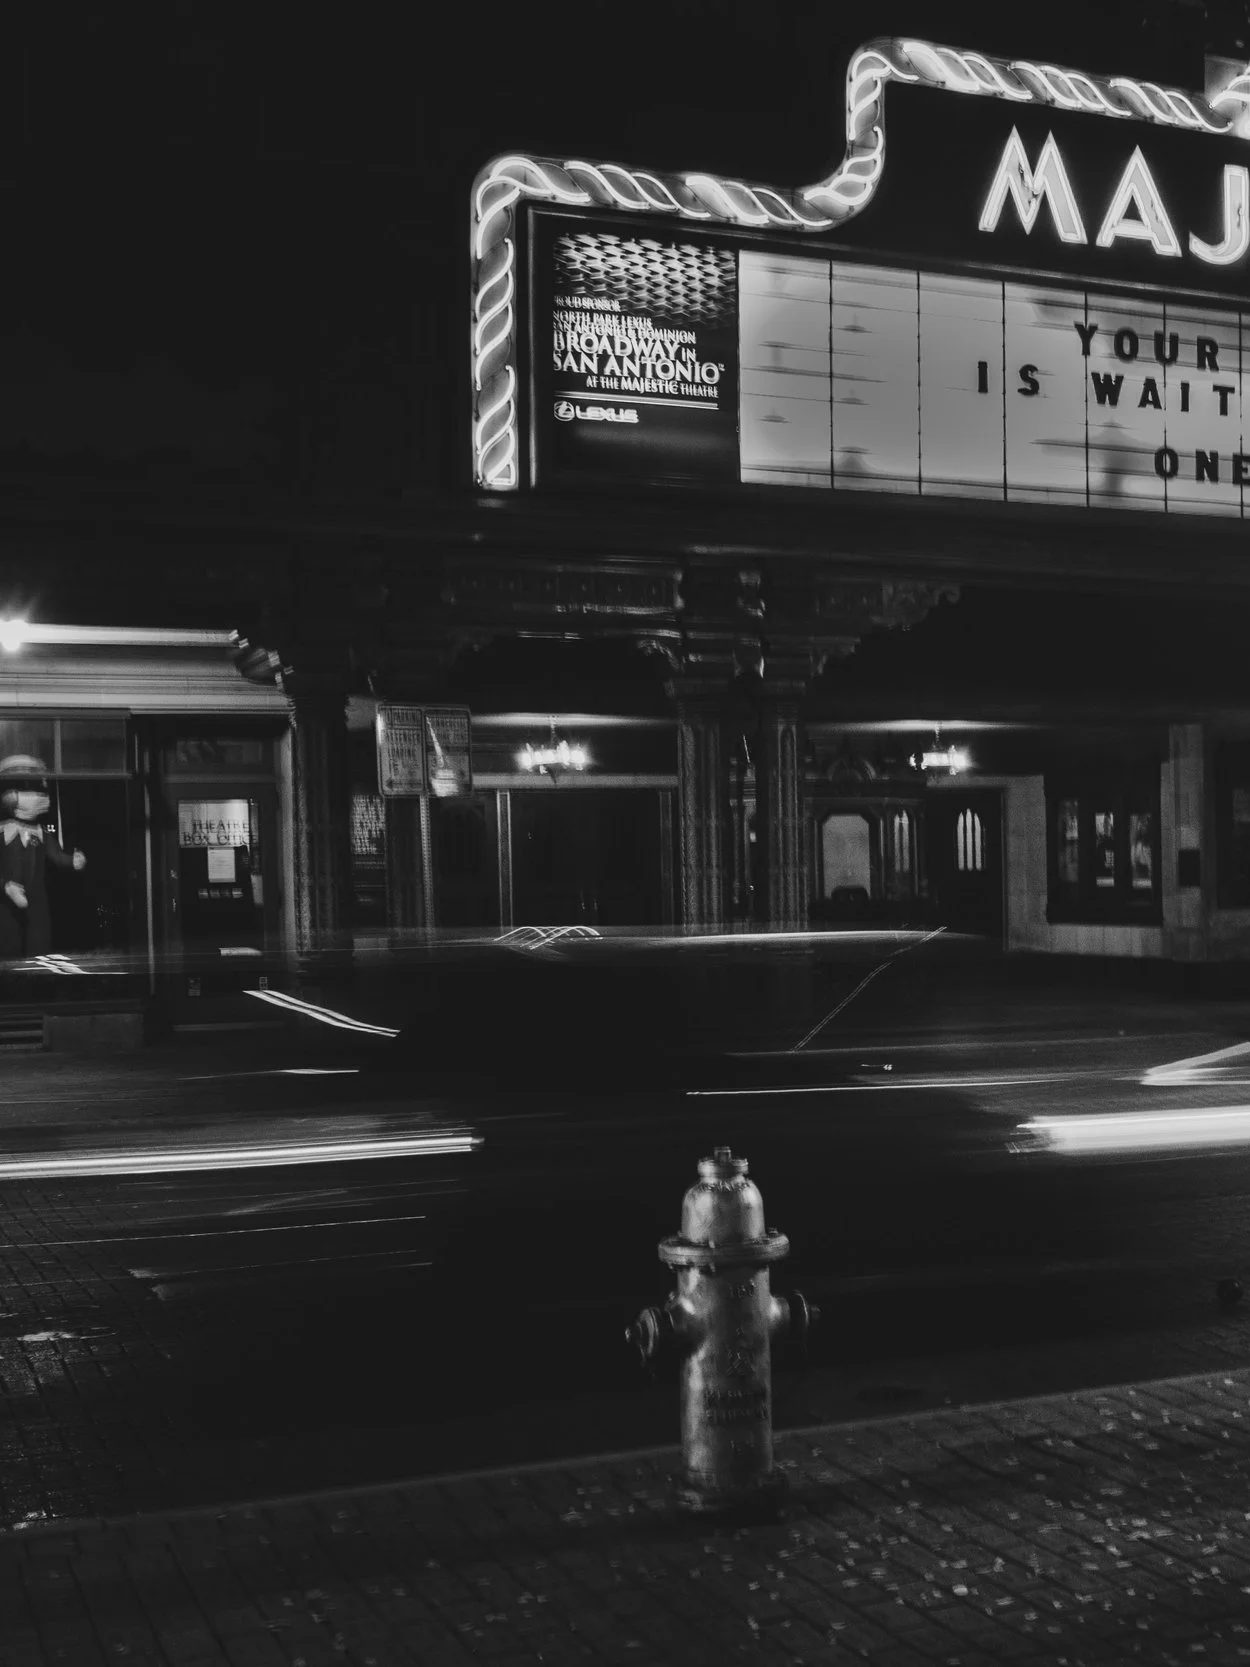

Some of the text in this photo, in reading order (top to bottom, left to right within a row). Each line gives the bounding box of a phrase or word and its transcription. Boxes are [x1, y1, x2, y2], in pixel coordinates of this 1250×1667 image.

[554, 329, 697, 364] BROADWAY IN
[1074, 321, 1220, 372] YOUR
[553, 350, 599, 375] SAN
[620, 376, 679, 395] MAJESTIC
[977, 360, 1041, 396] IS
[575, 405, 640, 424] LEXUS
